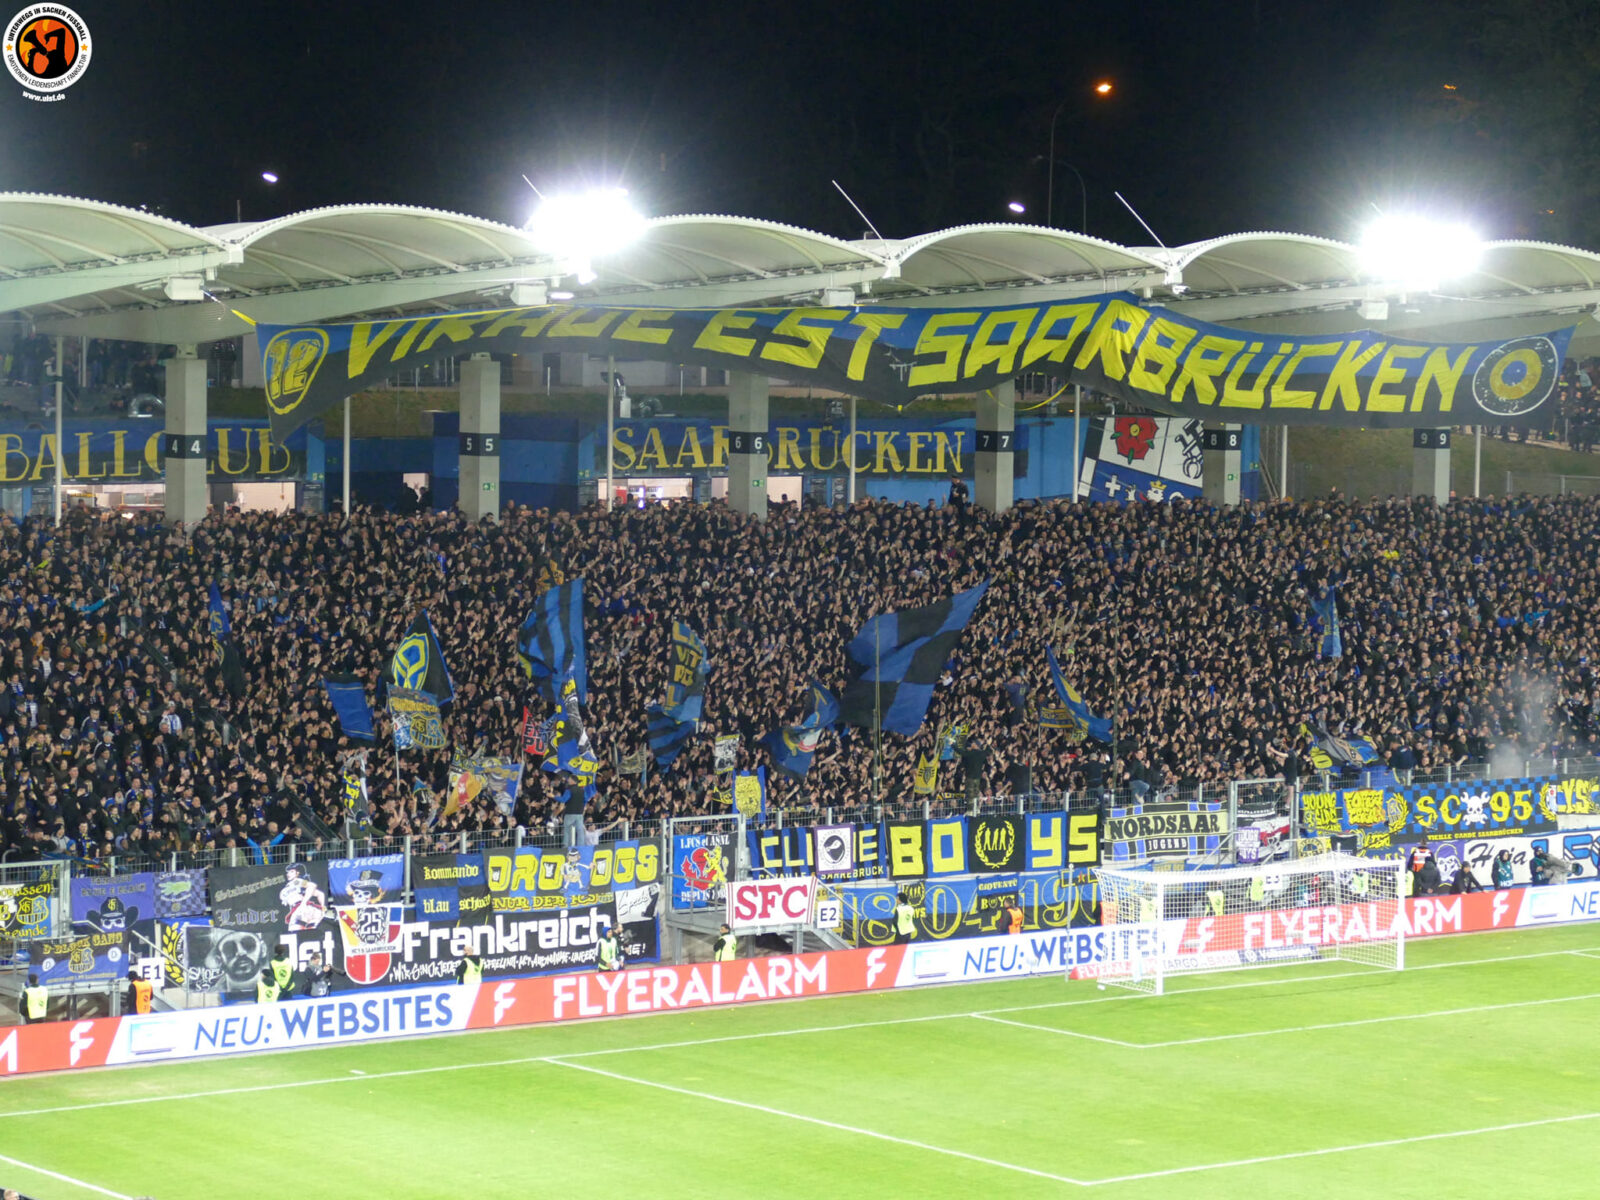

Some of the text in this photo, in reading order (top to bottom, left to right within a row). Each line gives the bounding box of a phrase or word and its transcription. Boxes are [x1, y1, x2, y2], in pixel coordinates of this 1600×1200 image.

[693, 307, 908, 381] EST
[908, 299, 1478, 413] SAARBRÜCKEN
[466, 437, 472, 451] 5
[485, 437, 494, 452] 5
[735, 436, 742, 449] 6
[755, 436, 763, 450] 6
[982, 435, 989, 447] 7
[1001, 435, 1009, 448] 7
[1211, 434, 1217, 446] 8
[1229, 434, 1237, 447] 8
[1420, 432, 1428, 445] 9
[1439, 433, 1447, 445] 9
[172, 441, 178, 454] 4
[190, 441, 201, 454] 4
[1489, 789, 1533, 822] 95
[1109, 813, 1221, 840] NORDSAAR
[1148, 837, 1188, 851] JUGEND
[492, 896, 531, 912] NUR
[533, 894, 567, 909] DER
[734, 883, 809, 921] SFC
[216, 907, 279, 927] Luder
[819, 906, 838, 922] E2
[359, 911, 382, 936] 25
[1243, 896, 1463, 951] FLYERALARM
[400, 911, 613, 963] Frankreich
[963, 944, 1026, 976] NEU:
[143, 964, 162, 980] E1
[552, 953, 828, 1020] FLYERALARM
[194, 987, 453, 1050] NEU: WEBSITES
